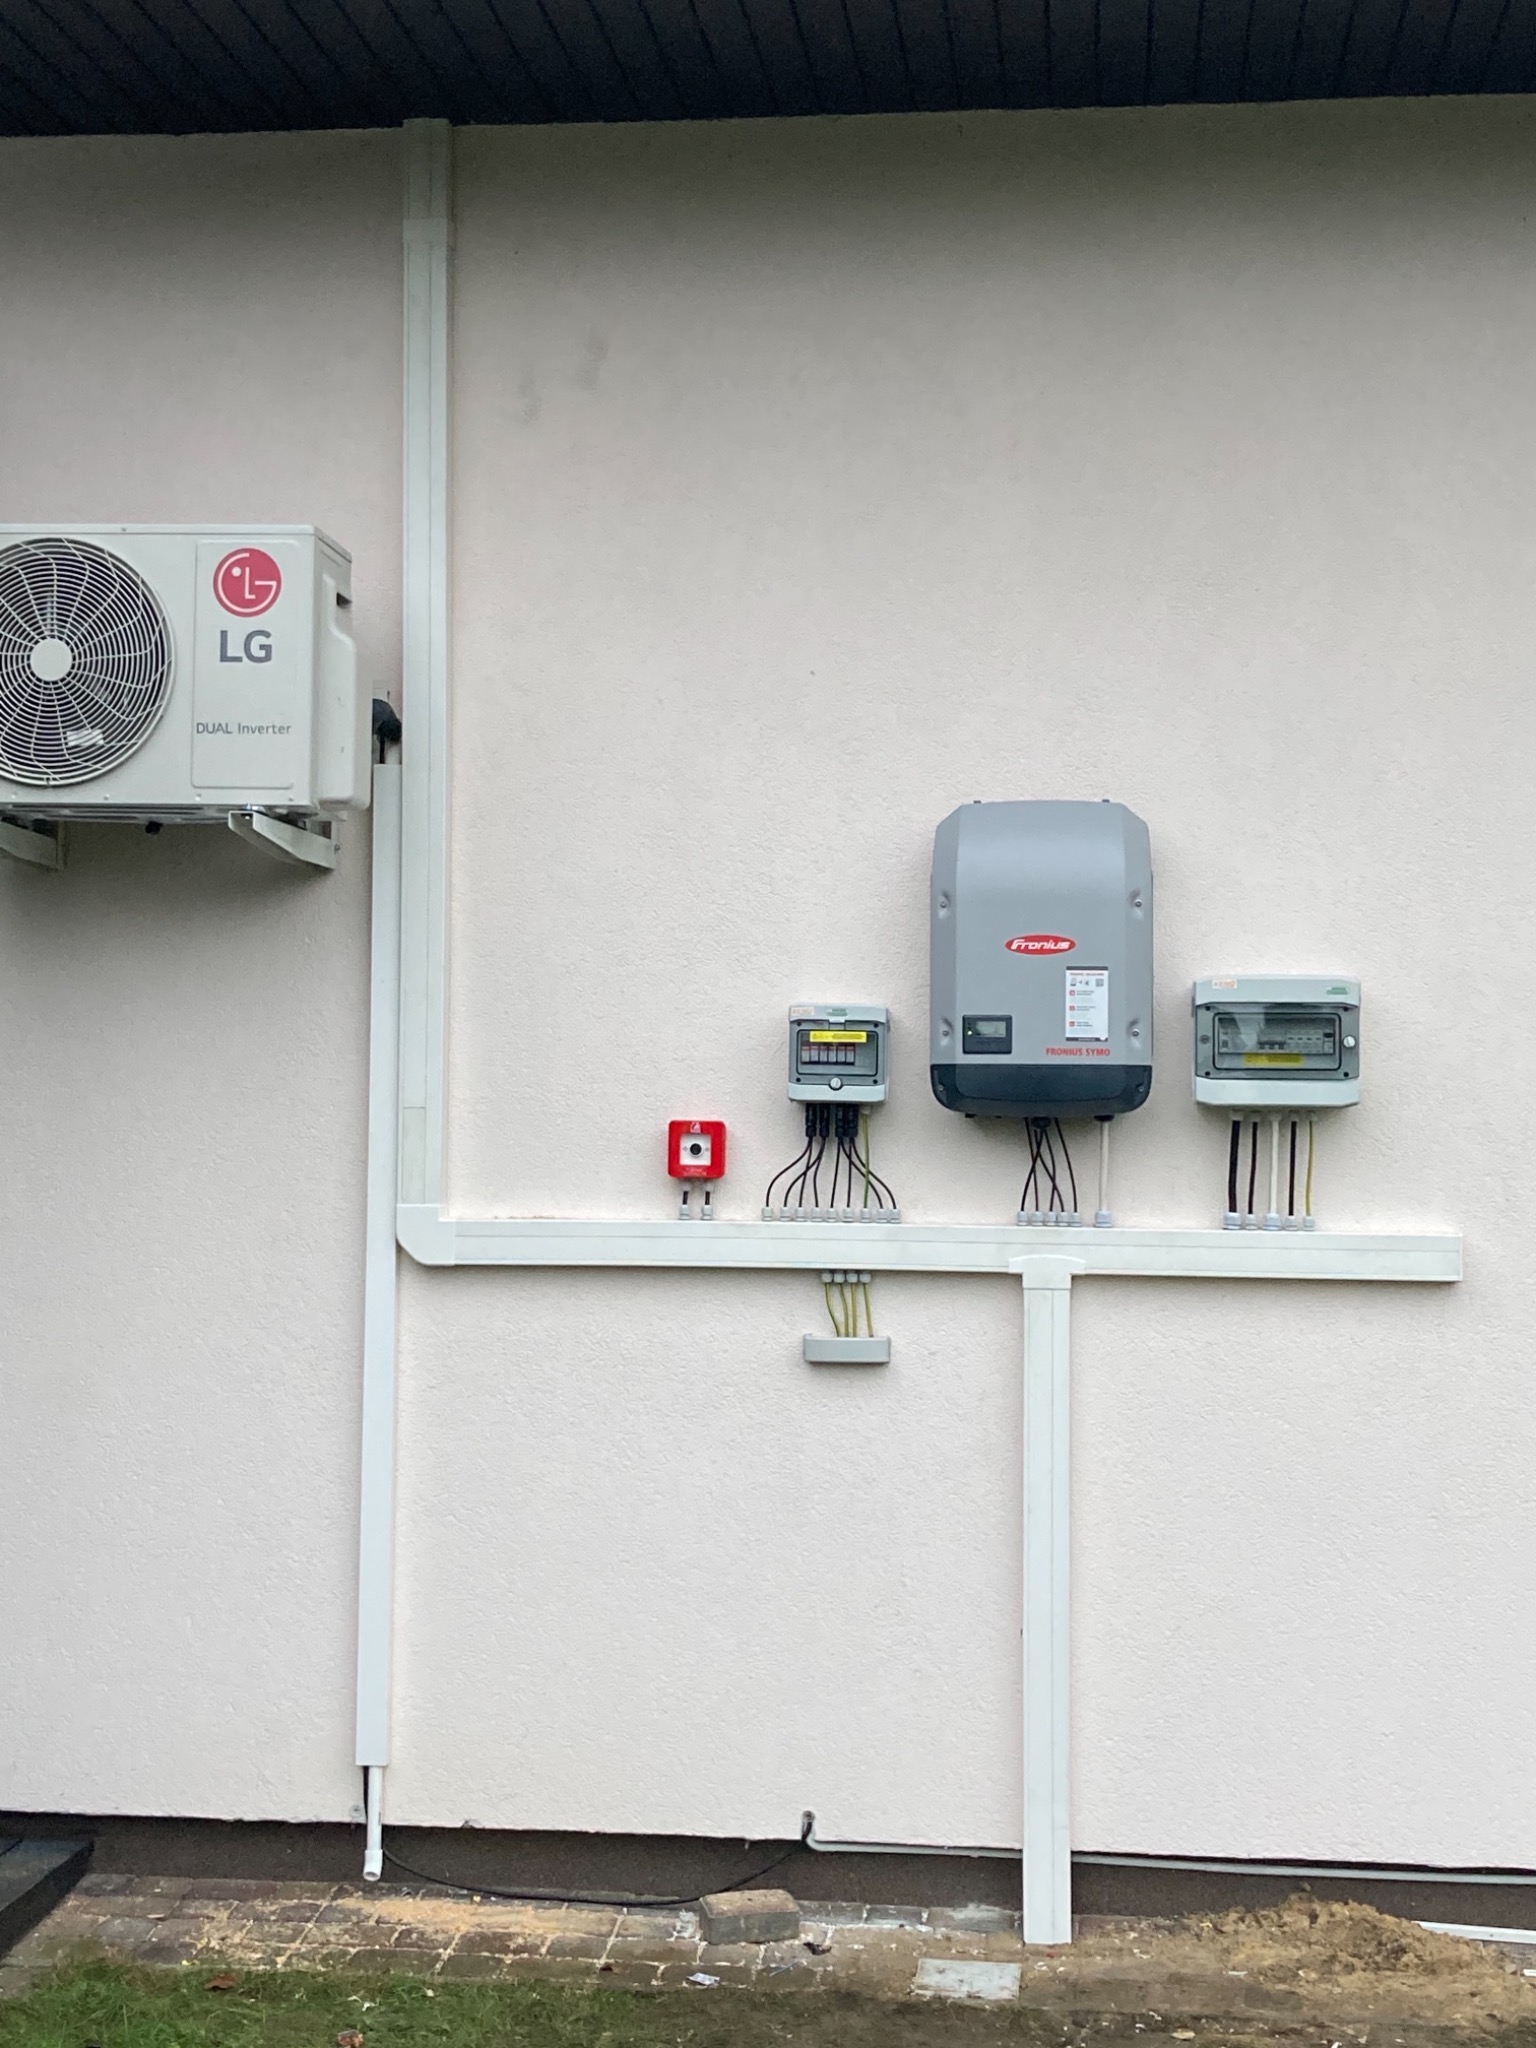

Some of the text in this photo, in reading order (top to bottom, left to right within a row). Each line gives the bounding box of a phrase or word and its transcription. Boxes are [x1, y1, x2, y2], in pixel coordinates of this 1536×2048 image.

[217, 552, 278, 614] LG
[219, 629, 273, 664] LG
[196, 722, 292, 735] DUAL Inverter
[1010, 939, 1071, 950] Fronius
[1046, 1047, 1111, 1056] FRONIUS SYMO
